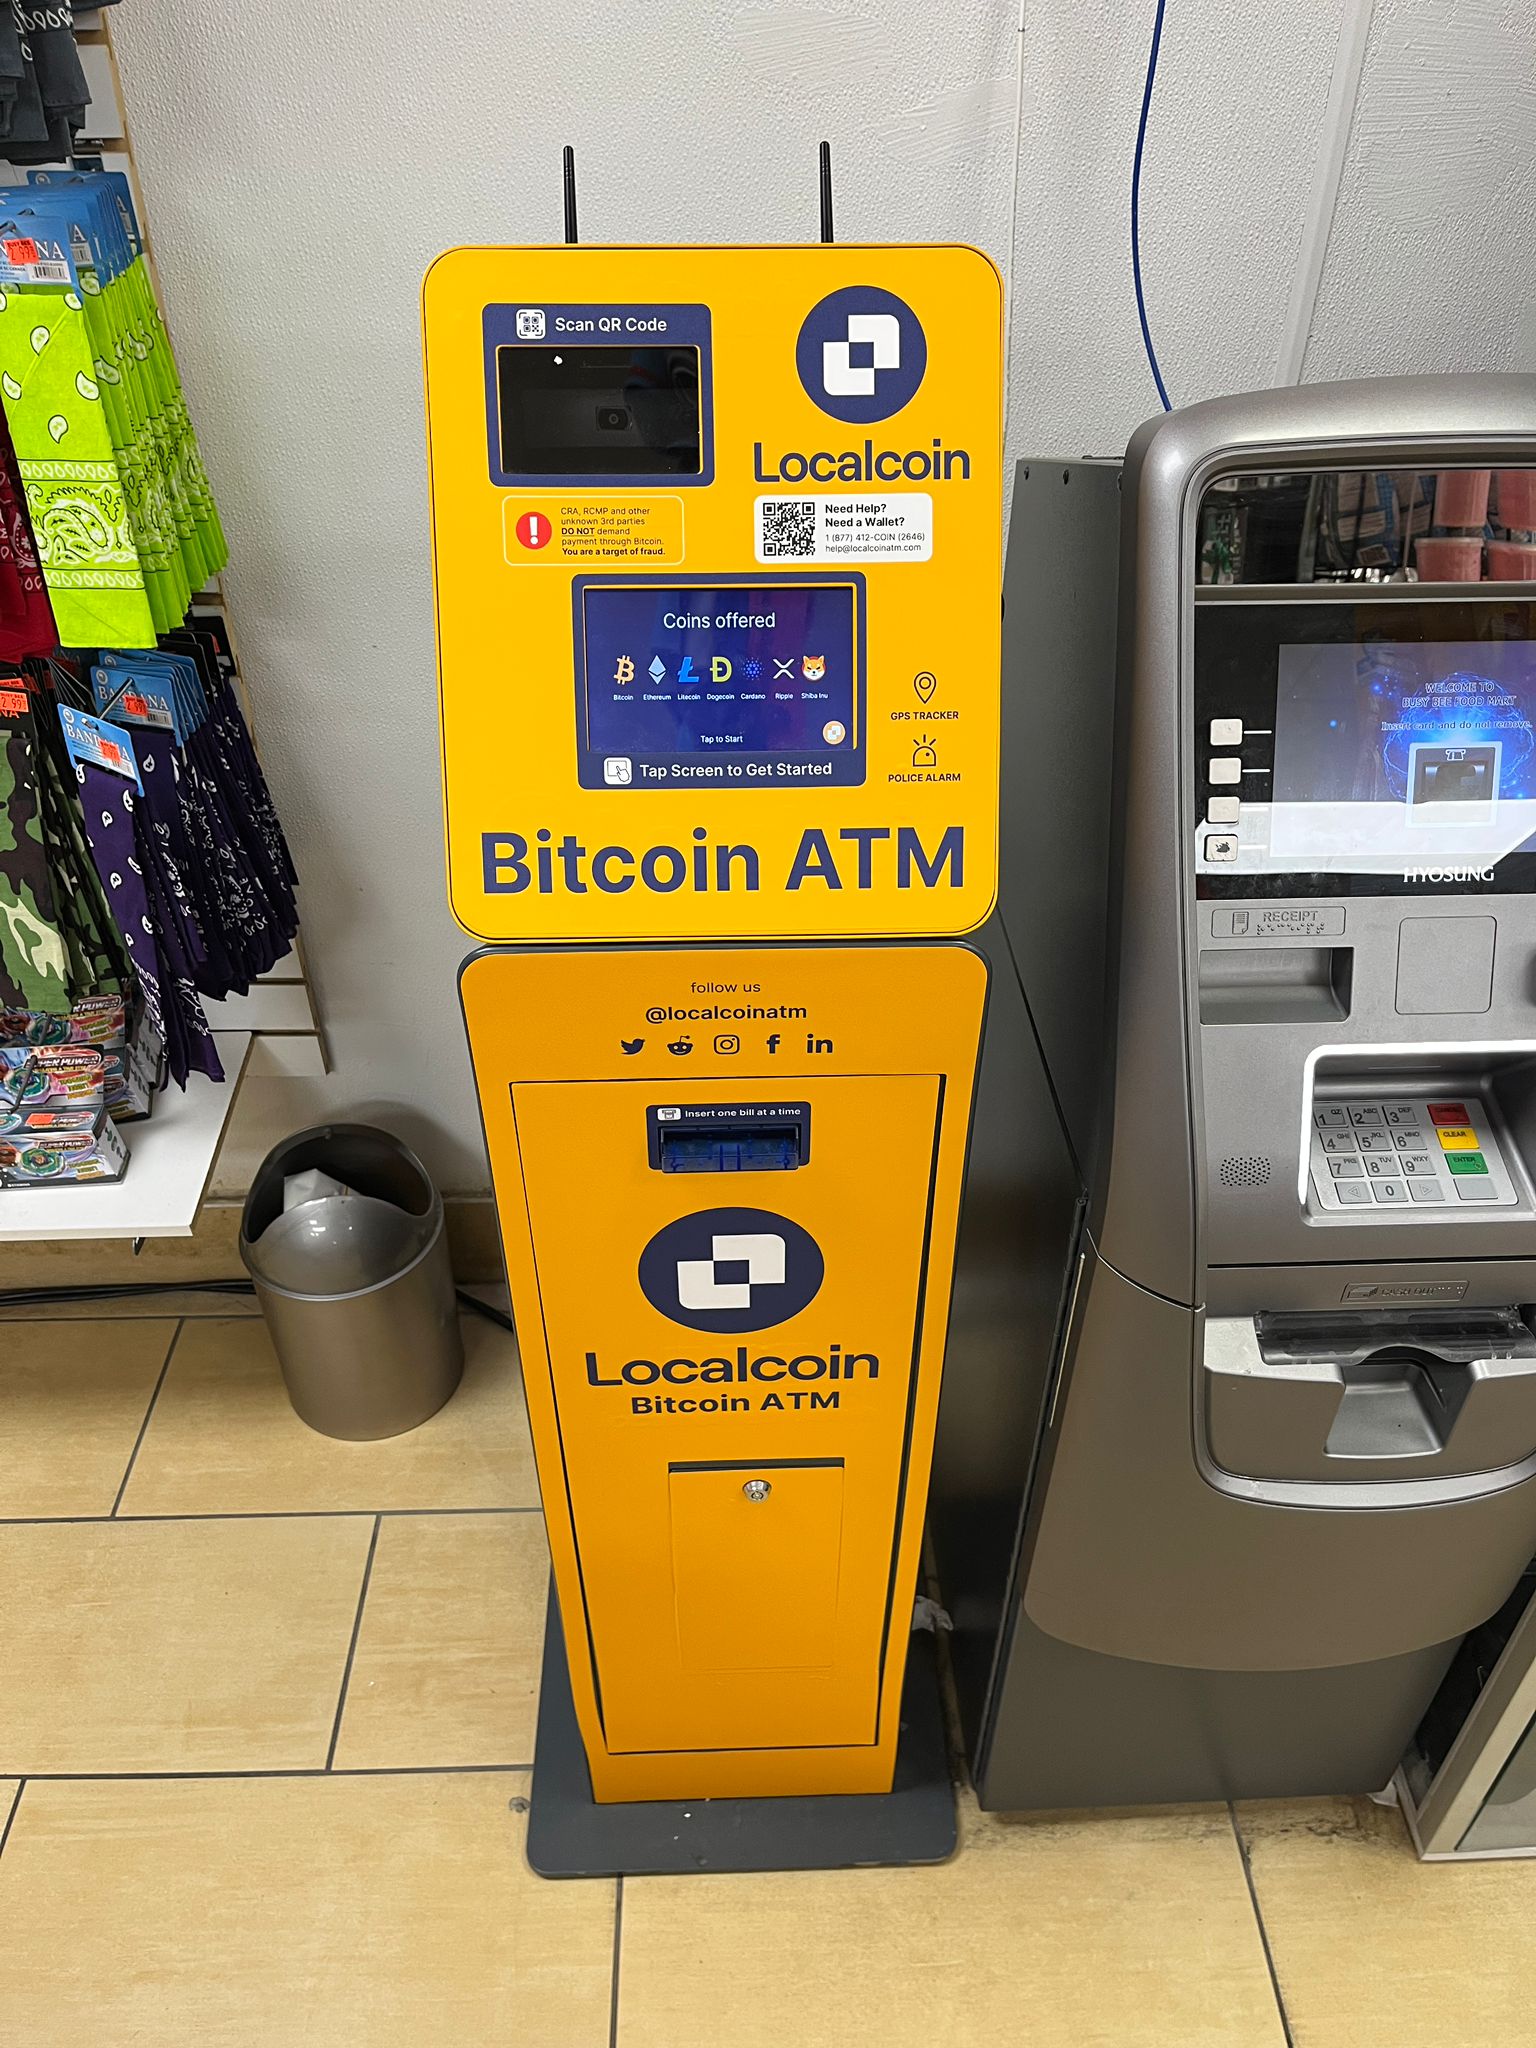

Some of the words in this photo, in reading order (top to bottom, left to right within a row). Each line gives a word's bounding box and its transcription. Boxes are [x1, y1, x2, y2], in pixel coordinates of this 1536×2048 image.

[555, 316, 595, 333] Scan
[598, 316, 622, 333] QR
[625, 316, 668, 333] Code
[754, 439, 971, 483] Localcoin
[560, 507, 582, 516] CRA,
[583, 507, 609, 515] RCMP
[610, 507, 626, 515] and
[627, 507, 651, 515] other
[825, 504, 854, 514] Need
[856, 503, 888, 516] Help?
[561, 517, 599, 525] unknown
[600, 517, 615, 525] 3rd
[616, 517, 646, 526] parties
[825, 517, 854, 528] Need
[855, 519, 863, 527] a
[864, 517, 906, 527] Wallet?
[561, 527, 575, 536] DO
[576, 527, 596, 536] NOT
[597, 527, 631, 535] demand
[561, 537, 598, 547] payment
[599, 537, 632, 547] through
[633, 537, 665, 545] Bitcoin.
[825, 534, 830, 542] 1
[832, 533, 853, 543] (877)
[855, 533, 896, 542] 412-COIN
[898, 532, 926, 542] (2646)
[562, 548, 578, 556] You
[602, 548, 628, 557] target
[630, 547, 639, 555] of
[640, 547, 666, 556] fraud.
[825, 543, 922, 554] help@localcoinatm.com
[663, 612, 711, 630] Coins
[715, 611, 777, 629] offered
[1425, 682, 1478, 694] WELCOME
[1479, 681, 1495, 692] TO
[613, 693, 635, 701] Bitcoin
[643, 693, 672, 701] Ethereum
[677, 693, 701, 701] Litecoin
[706, 693, 735, 702] Dogecoin
[740, 692, 766, 700] Cardano
[775, 692, 794, 701] Ripple
[801, 692, 818, 700] Shiba
[819, 692, 829, 700] Inu
[1402, 696, 1430, 708] BUSY
[1432, 696, 1453, 707] BEE
[1455, 696, 1485, 706] FOOD
[1488, 695, 1517, 706] MART
[890, 711, 911, 720] GPS
[913, 710, 959, 720] TRACKER
[1381, 721, 1412, 731] Insert
[1413, 721, 1435, 730] card
[1438, 720, 1456, 730] and
[1459, 720, 1473, 729] do
[1475, 720, 1491, 729] not
[1494, 719, 1533, 729] remove.
[700, 735, 714, 745] Tap
[715, 735, 724, 744] to
[725, 735, 744, 744] Start
[640, 764, 668, 781] Tap
[671, 763, 724, 778] Screen
[727, 763, 742, 777] to
[746, 762, 773, 777] Get
[776, 762, 833, 776] Started
[888, 773, 923, 783] POLICE
[925, 773, 961, 782] ALARM
[481, 826, 760, 895] Bitcoin
[784, 826, 965, 891] ATM
[1403, 866, 1495, 883] HYOSUNG
[1263, 910, 1319, 922] RECEIPT
[690, 981, 737, 994] follow
[743, 983, 761, 994] us
[645, 1004, 808, 1025] @localcoinatm
[685, 1110, 715, 1118] Insert
[717, 1110, 737, 1118] one
[756, 1108, 768, 1116] at
[778, 1107, 801, 1116] time
[1354, 1112, 1365, 1124] 2
[1389, 1111, 1400, 1123] 3
[1318, 1114, 1327, 1125] 1
[1327, 1138, 1336, 1149] 4
[1361, 1137, 1372, 1148] 5
[1397, 1136, 1407, 1147] 6
[1332, 1163, 1341, 1175] 7
[1370, 1162, 1380, 1173] 8
[1405, 1160, 1415, 1172] 9
[1385, 1185, 1395, 1197] 0
[585, 1344, 880, 1387] Localcoin
[631, 1393, 750, 1415] Bitcoin
[760, 1391, 840, 1412] ATM
